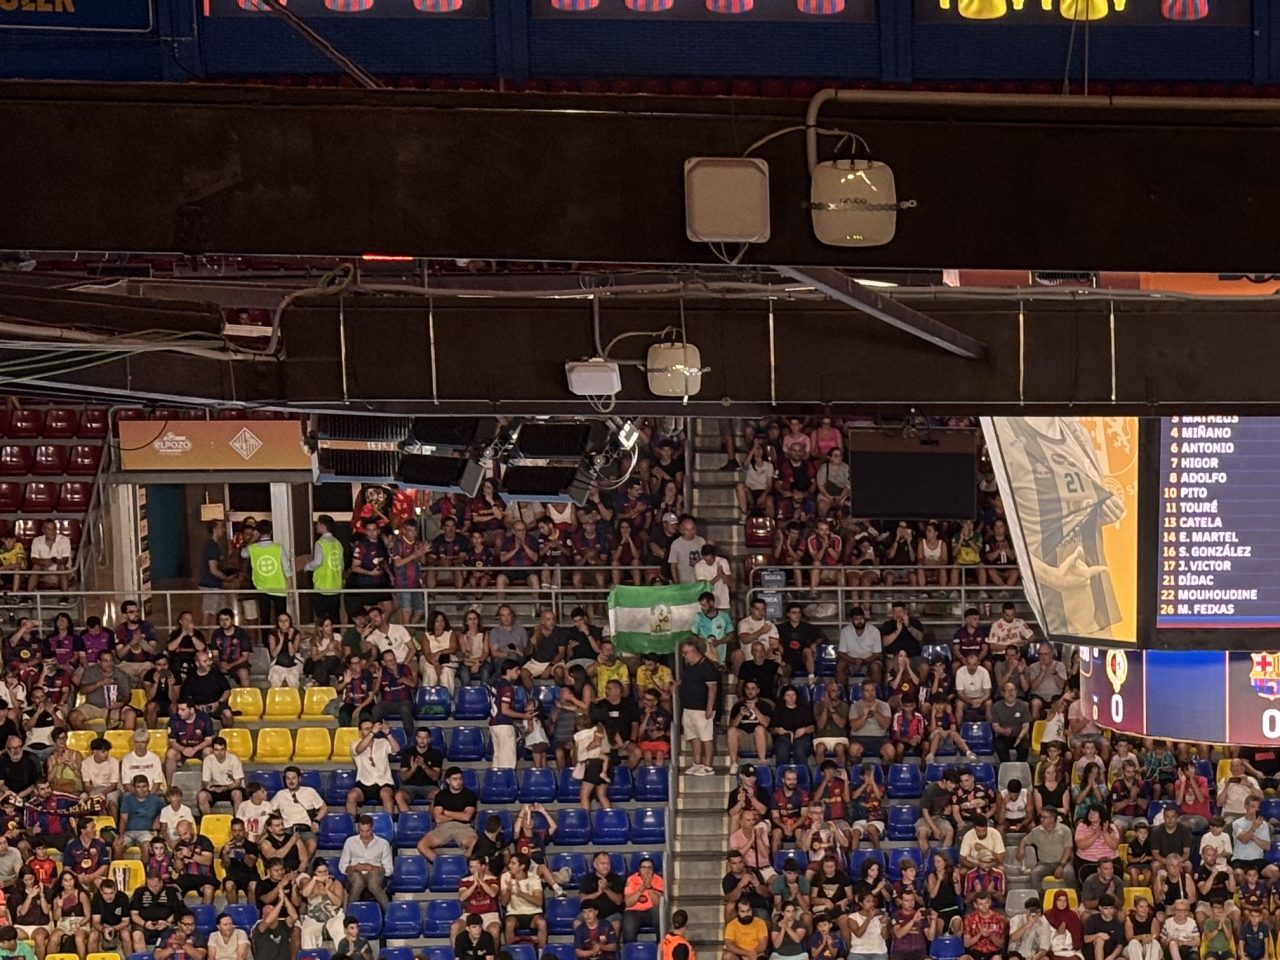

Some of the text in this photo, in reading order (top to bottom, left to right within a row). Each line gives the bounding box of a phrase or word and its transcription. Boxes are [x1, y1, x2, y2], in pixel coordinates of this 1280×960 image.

[1170, 427, 1178, 438] 4
[1182, 425, 1232, 438] MIÑANO
[1170, 442, 1178, 453] 6
[1181, 442, 1234, 453] ANTONIO
[1170, 458, 1178, 468] 7
[1181, 458, 1218, 468] HIGOR
[1169, 472, 1178, 483] 8
[1180, 472, 1227, 483] ADOLFO
[1164, 488, 1177, 498] 10
[1180, 488, 1208, 498] PITO
[1166, 502, 1176, 513] 11
[1180, 499, 1218, 513] TOURÉ
[1164, 517, 1176, 528] 13
[1179, 517, 1222, 528] CATELA
[1163, 532, 1176, 542] 14
[1179, 532, 1190, 542] E.
[1192, 532, 1238, 542] MARTEL
[1163, 546, 1176, 557] 16
[1178, 546, 1189, 557] S.
[1191, 544, 1251, 557] GONZÁLEZ
[1163, 560, 1176, 571] 17
[1178, 560, 1188, 571] J.
[1190, 560, 1231, 571] VICTOR
[1162, 575, 1175, 586] 21
[1178, 572, 1214, 586] DÍDAC
[1161, 590, 1175, 600] 22
[1178, 590, 1258, 600] MOUHOUDINE
[1160, 604, 1174, 614] 26
[1177, 604, 1192, 614] M.
[1194, 604, 1234, 614] FEIXAS
[1111, 694, 1124, 724] 0
